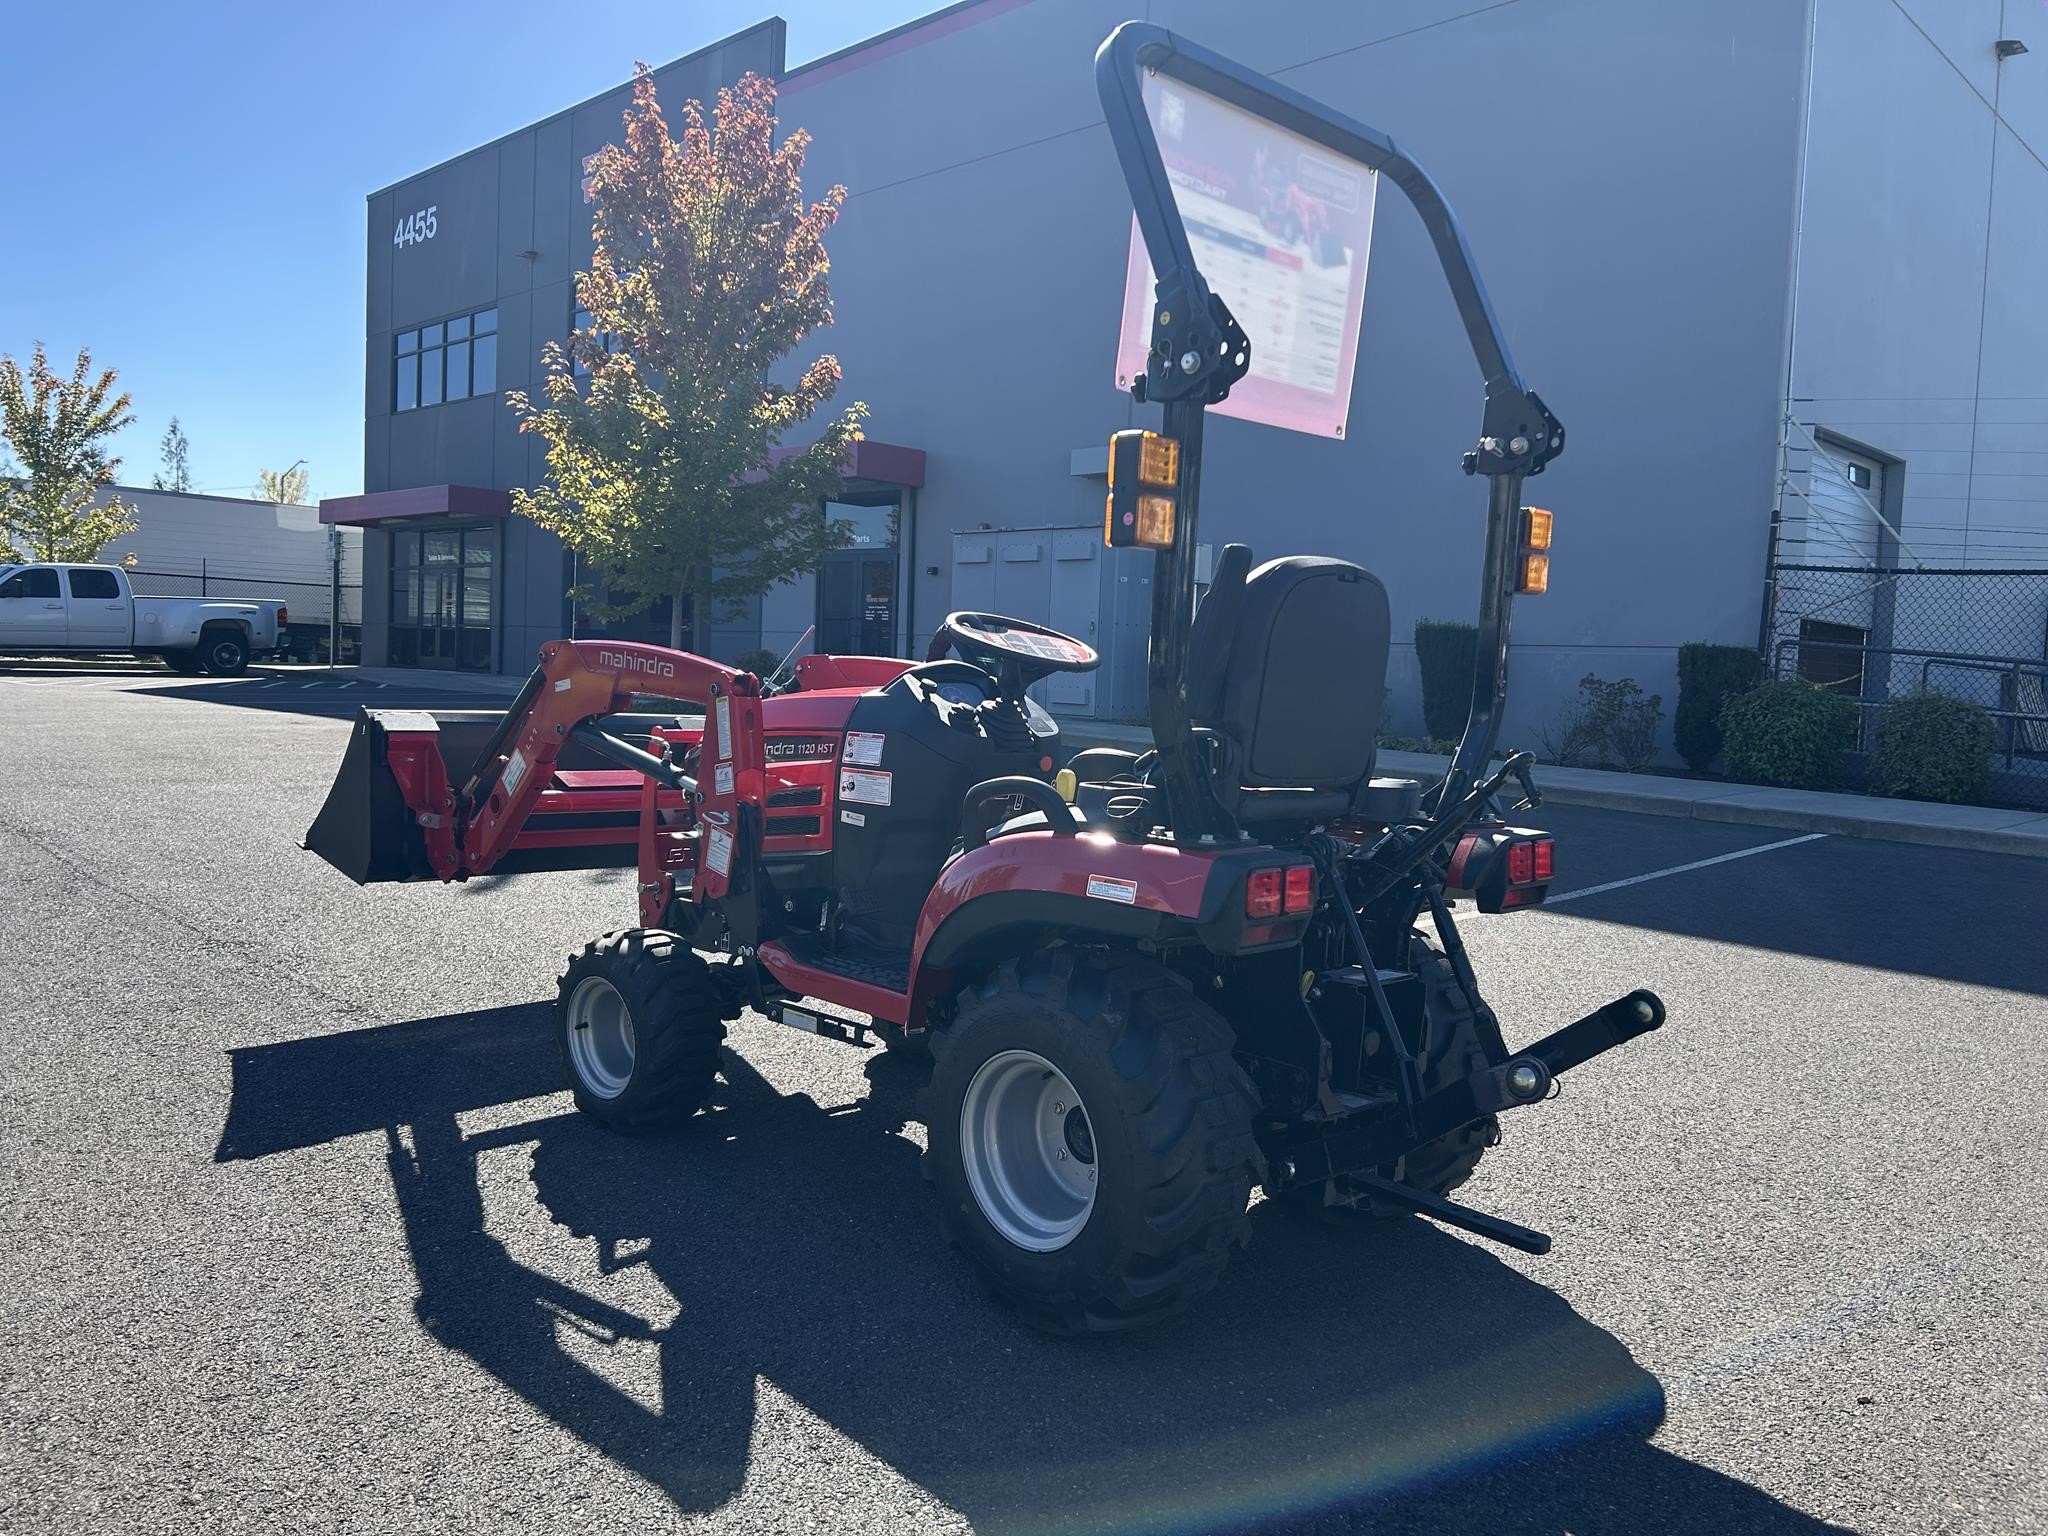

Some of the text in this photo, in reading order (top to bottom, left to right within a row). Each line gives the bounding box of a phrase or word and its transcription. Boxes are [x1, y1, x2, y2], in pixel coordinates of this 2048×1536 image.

[393, 205, 437, 249] 4455
[599, 650, 674, 678] mahindra
[797, 743, 816, 755] 1120
[817, 743, 835, 754] HST
